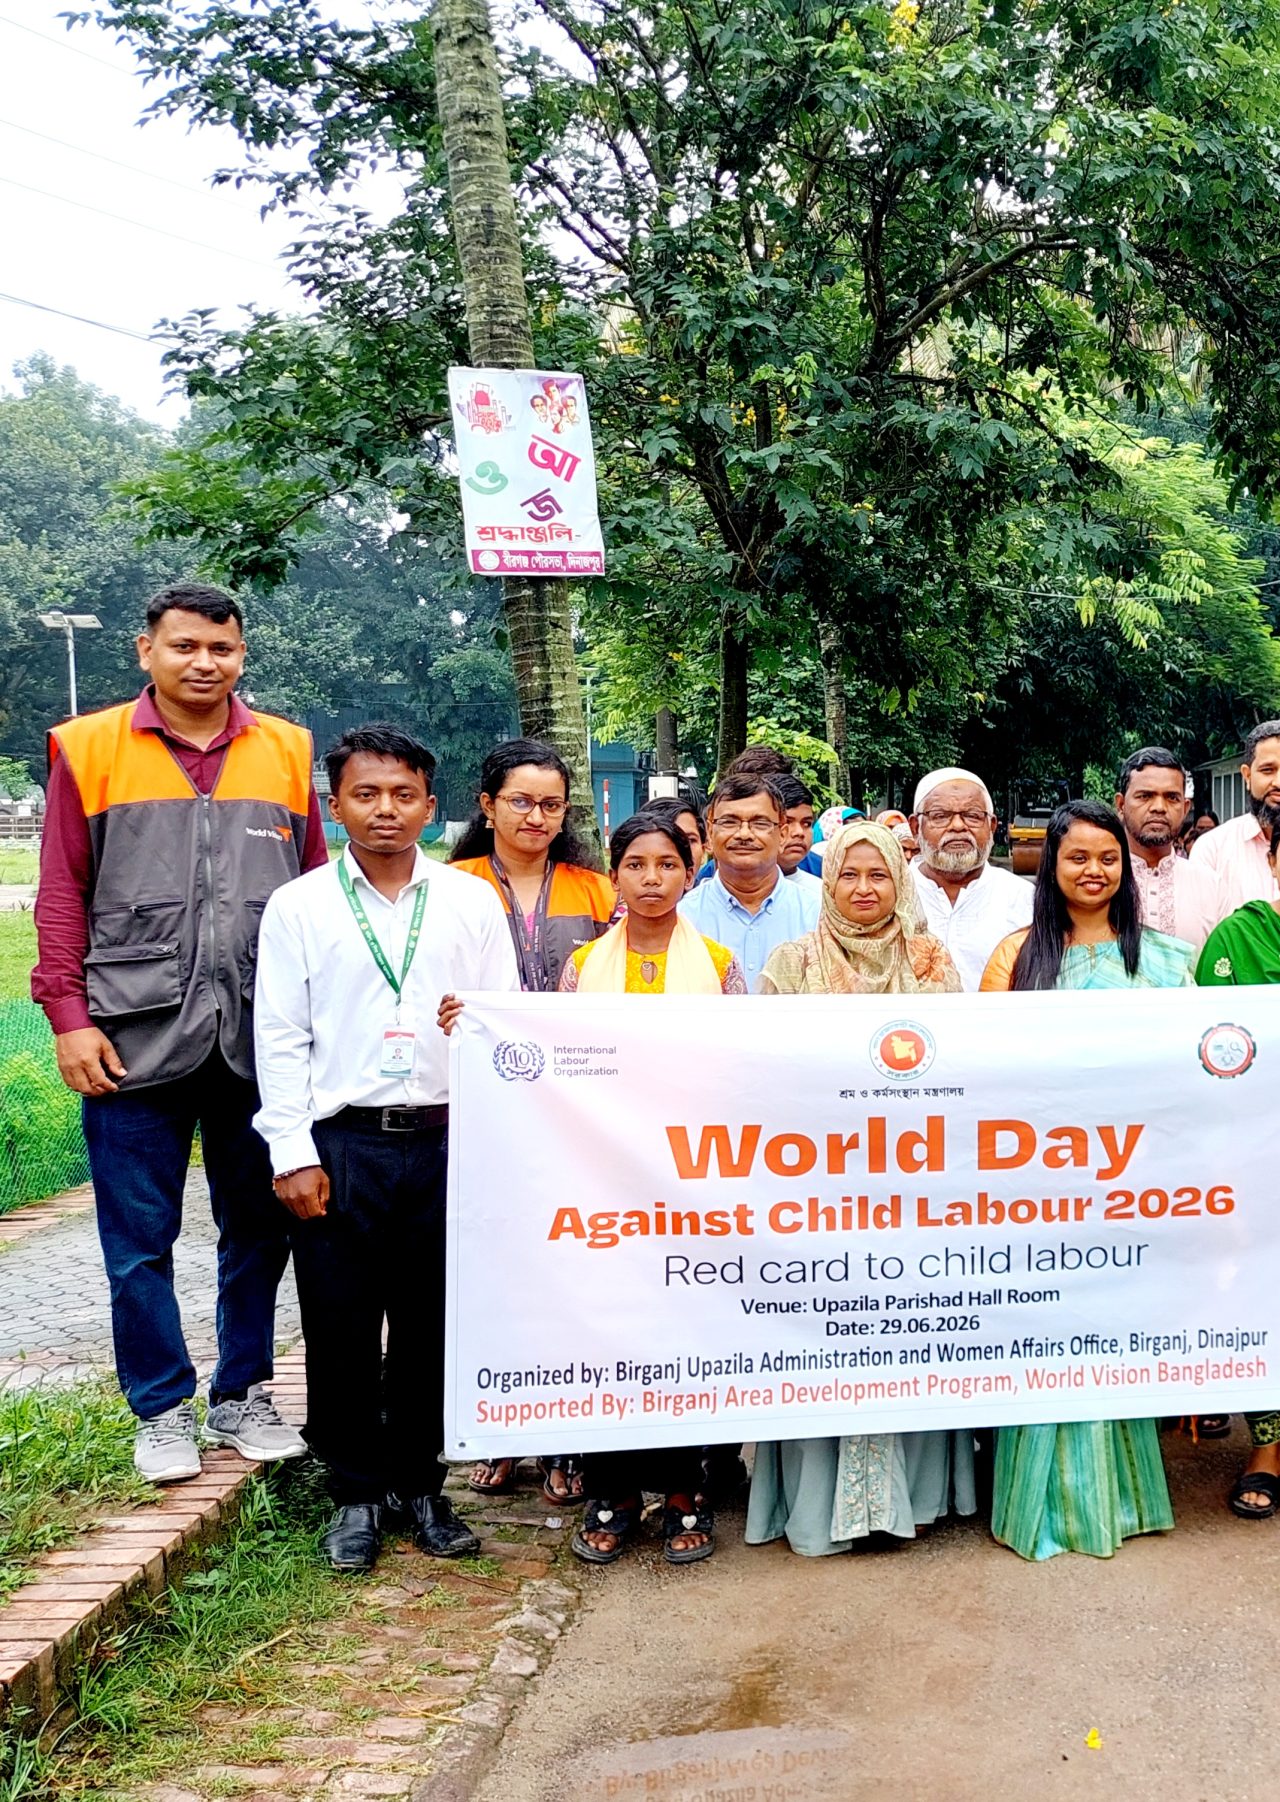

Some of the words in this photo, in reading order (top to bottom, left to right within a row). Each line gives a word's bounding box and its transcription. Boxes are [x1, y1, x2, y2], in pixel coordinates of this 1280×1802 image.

[528, 434, 581, 483] আ
[554, 1046, 617, 1054] International
[554, 1056, 589, 1065] Labour
[554, 1067, 618, 1077] Organization
[860, 1090, 868, 1098] ও
[666, 1115, 945, 1180] World
[978, 1119, 1145, 1181] Day
[547, 1202, 755, 1249] Against
[769, 1194, 902, 1234] Child
[917, 1191, 1093, 1228] Labour
[1104, 1185, 1236, 1221] 2026
[665, 1255, 744, 1287] Red
[759, 1251, 849, 1284] card
[865, 1252, 904, 1281] to
[919, 1245, 1011, 1278] child
[1027, 1241, 1150, 1273] labour
[741, 1299, 808, 1315] Venue:
[812, 1294, 880, 1317] Upazila
[885, 1290, 962, 1311] Parishad
[968, 1288, 1002, 1307] Hall
[1008, 1288, 1060, 1305] Room
[825, 1320, 875, 1337] Date:
[880, 1315, 981, 1335] 29.06.2026
[477, 1363, 574, 1393] Organized
[581, 1362, 610, 1388] by:
[616, 1357, 681, 1385] Birganj
[687, 1353, 754, 1381] Upazila
[760, 1346, 893, 1373] Administration
[899, 1343, 931, 1365] and
[936, 1342, 1004, 1363] Women
[1009, 1337, 1065, 1359] Affairs
[1070, 1334, 1124, 1357] Office,
[1129, 1330, 1192, 1356] Birganj,
[1198, 1326, 1268, 1352] Dinajpur
[477, 1392, 594, 1427] Supported
[602, 1393, 635, 1420] By:
[642, 1386, 718, 1416] Birganj
[724, 1385, 773, 1408] Area
[781, 1376, 920, 1405] Development
[927, 1370, 1018, 1399] Program,
[1025, 1364, 1084, 1390] World
[1091, 1363, 1151, 1387] Vision
[1158, 1356, 1267, 1386] Bangladesh
